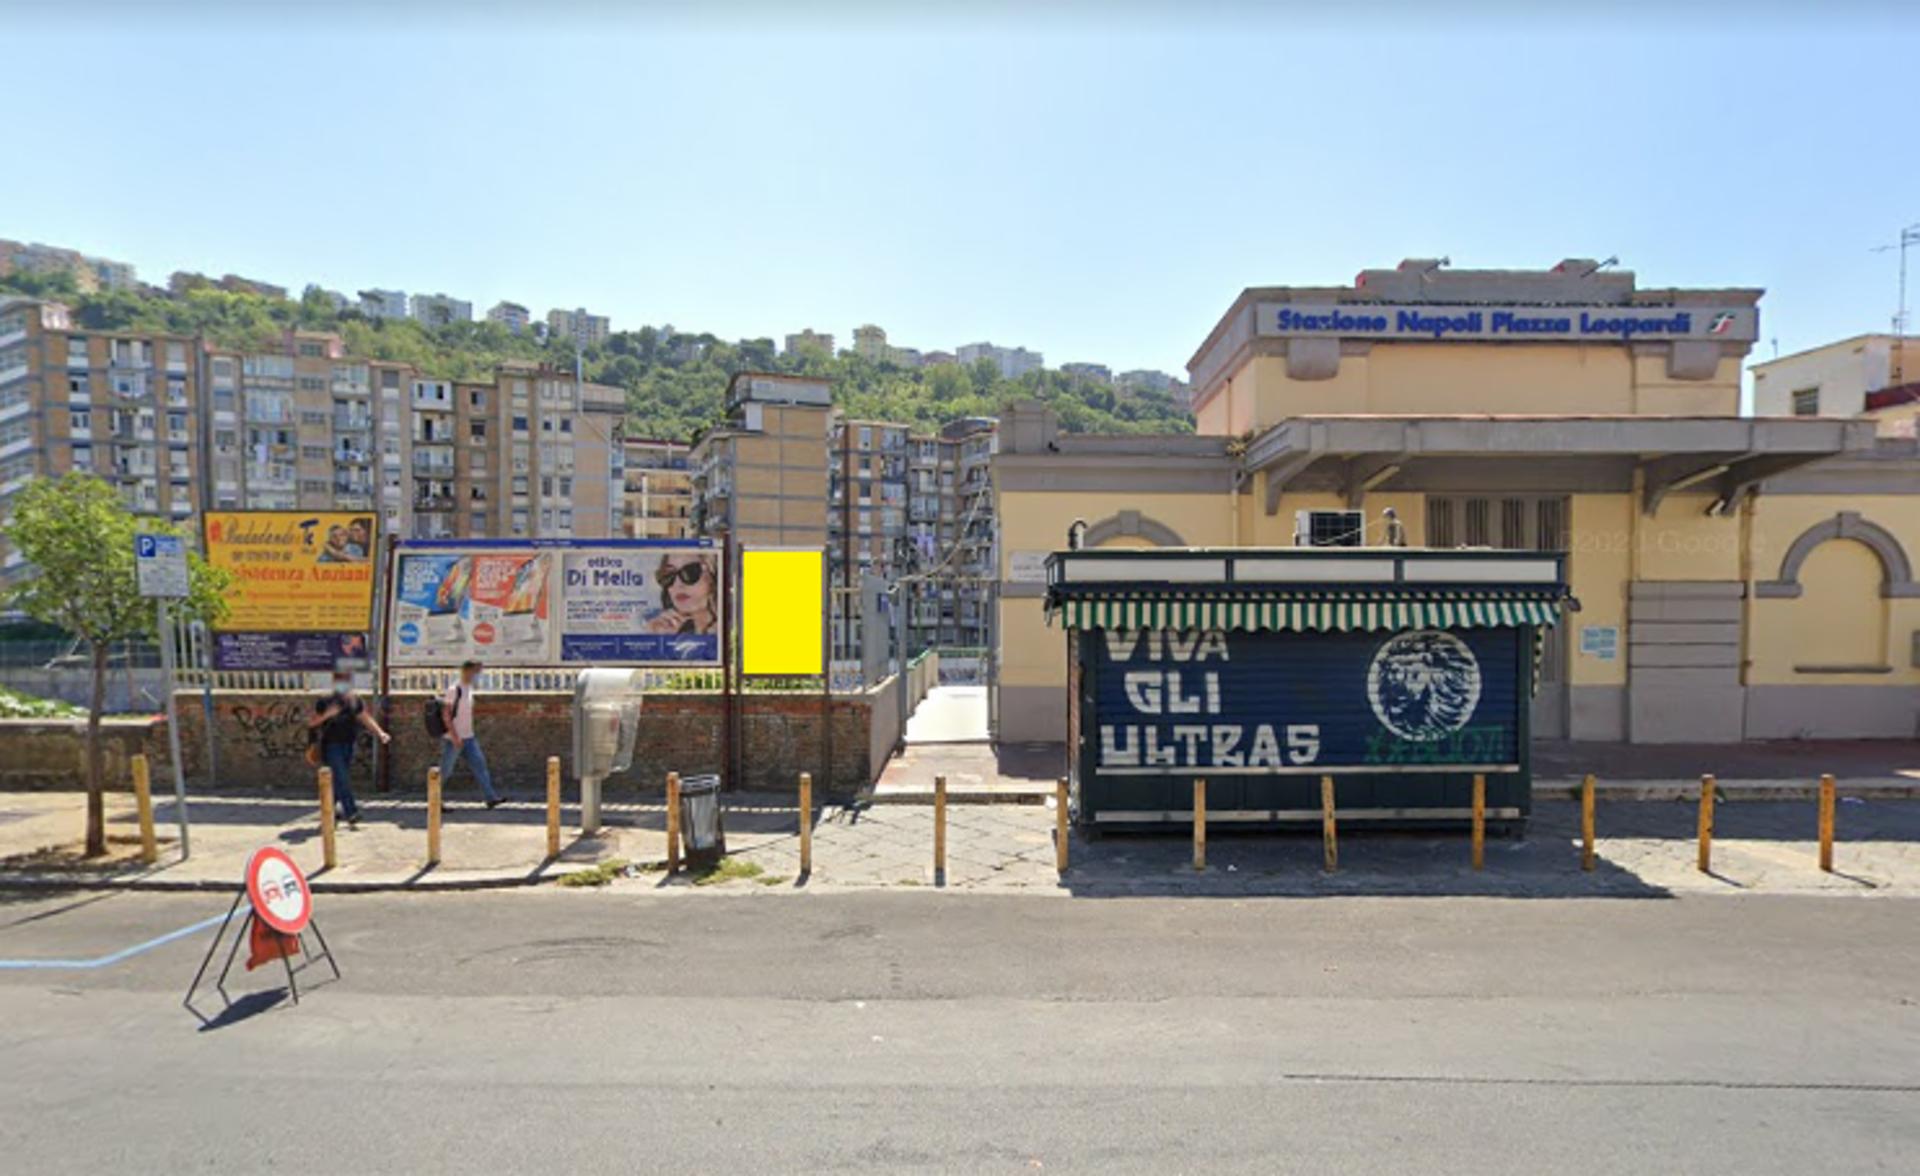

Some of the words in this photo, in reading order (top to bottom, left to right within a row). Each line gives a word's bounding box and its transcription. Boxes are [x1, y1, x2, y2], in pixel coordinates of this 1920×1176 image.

[1277, 308, 1388, 331] Stazione
[1396, 310, 1483, 338] Napoli
[1491, 310, 1571, 333] Piazza
[1579, 312, 1691, 339] Leopardi
[567, 569, 587, 587] Di
[1106, 630, 1230, 662] VIVA
[1123, 671, 1222, 714] GLI
[1100, 723, 1321, 767] ULTRAS
